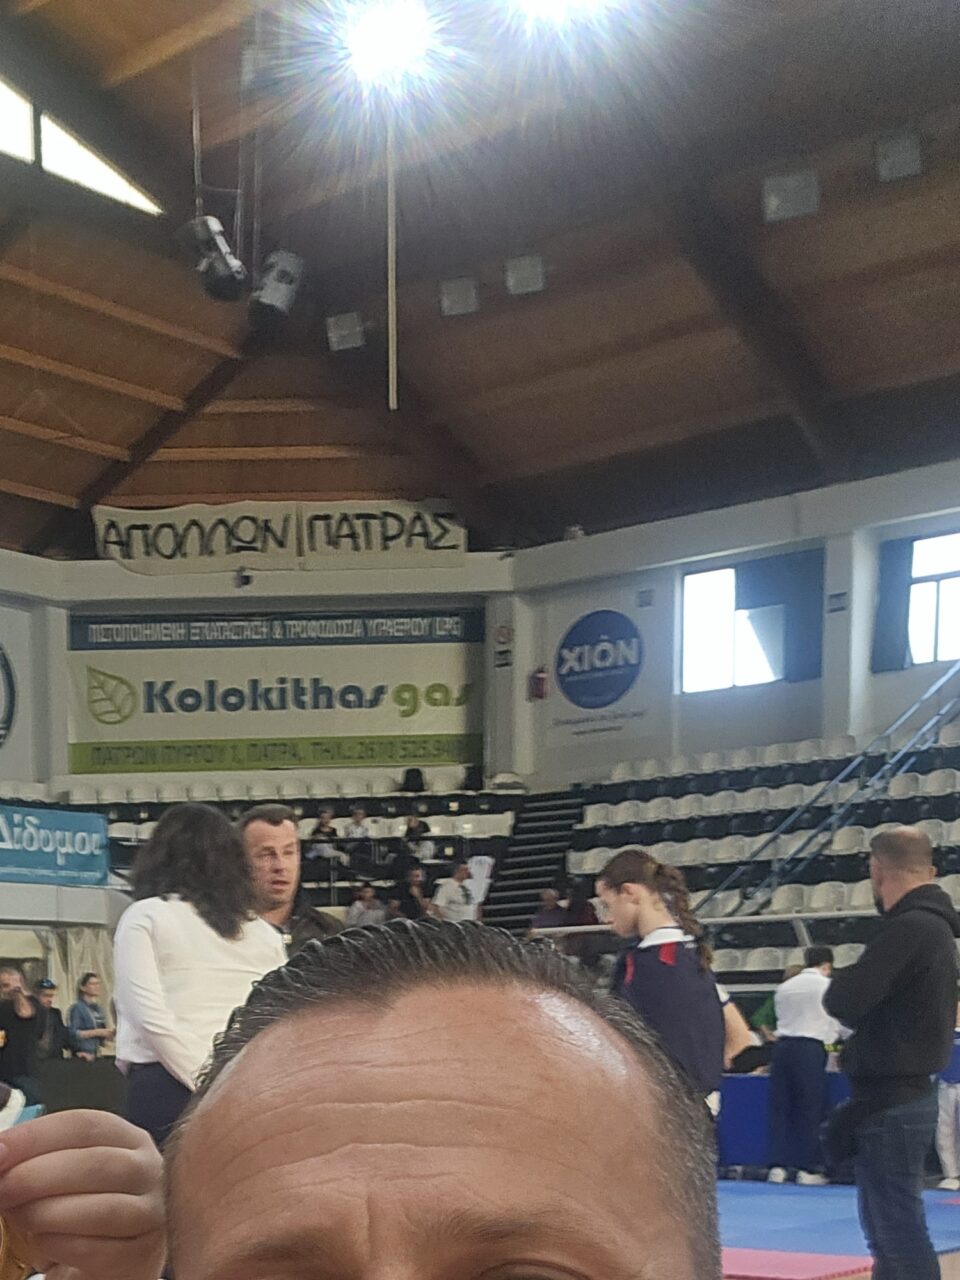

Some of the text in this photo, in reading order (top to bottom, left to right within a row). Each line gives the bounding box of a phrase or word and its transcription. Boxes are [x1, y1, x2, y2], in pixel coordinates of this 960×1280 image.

[103, 511, 460, 559] ΑΠΟΛΛΩΝ ΠΑΤΡΑΣ
[142, 677, 469, 718] Kolokithas gas
